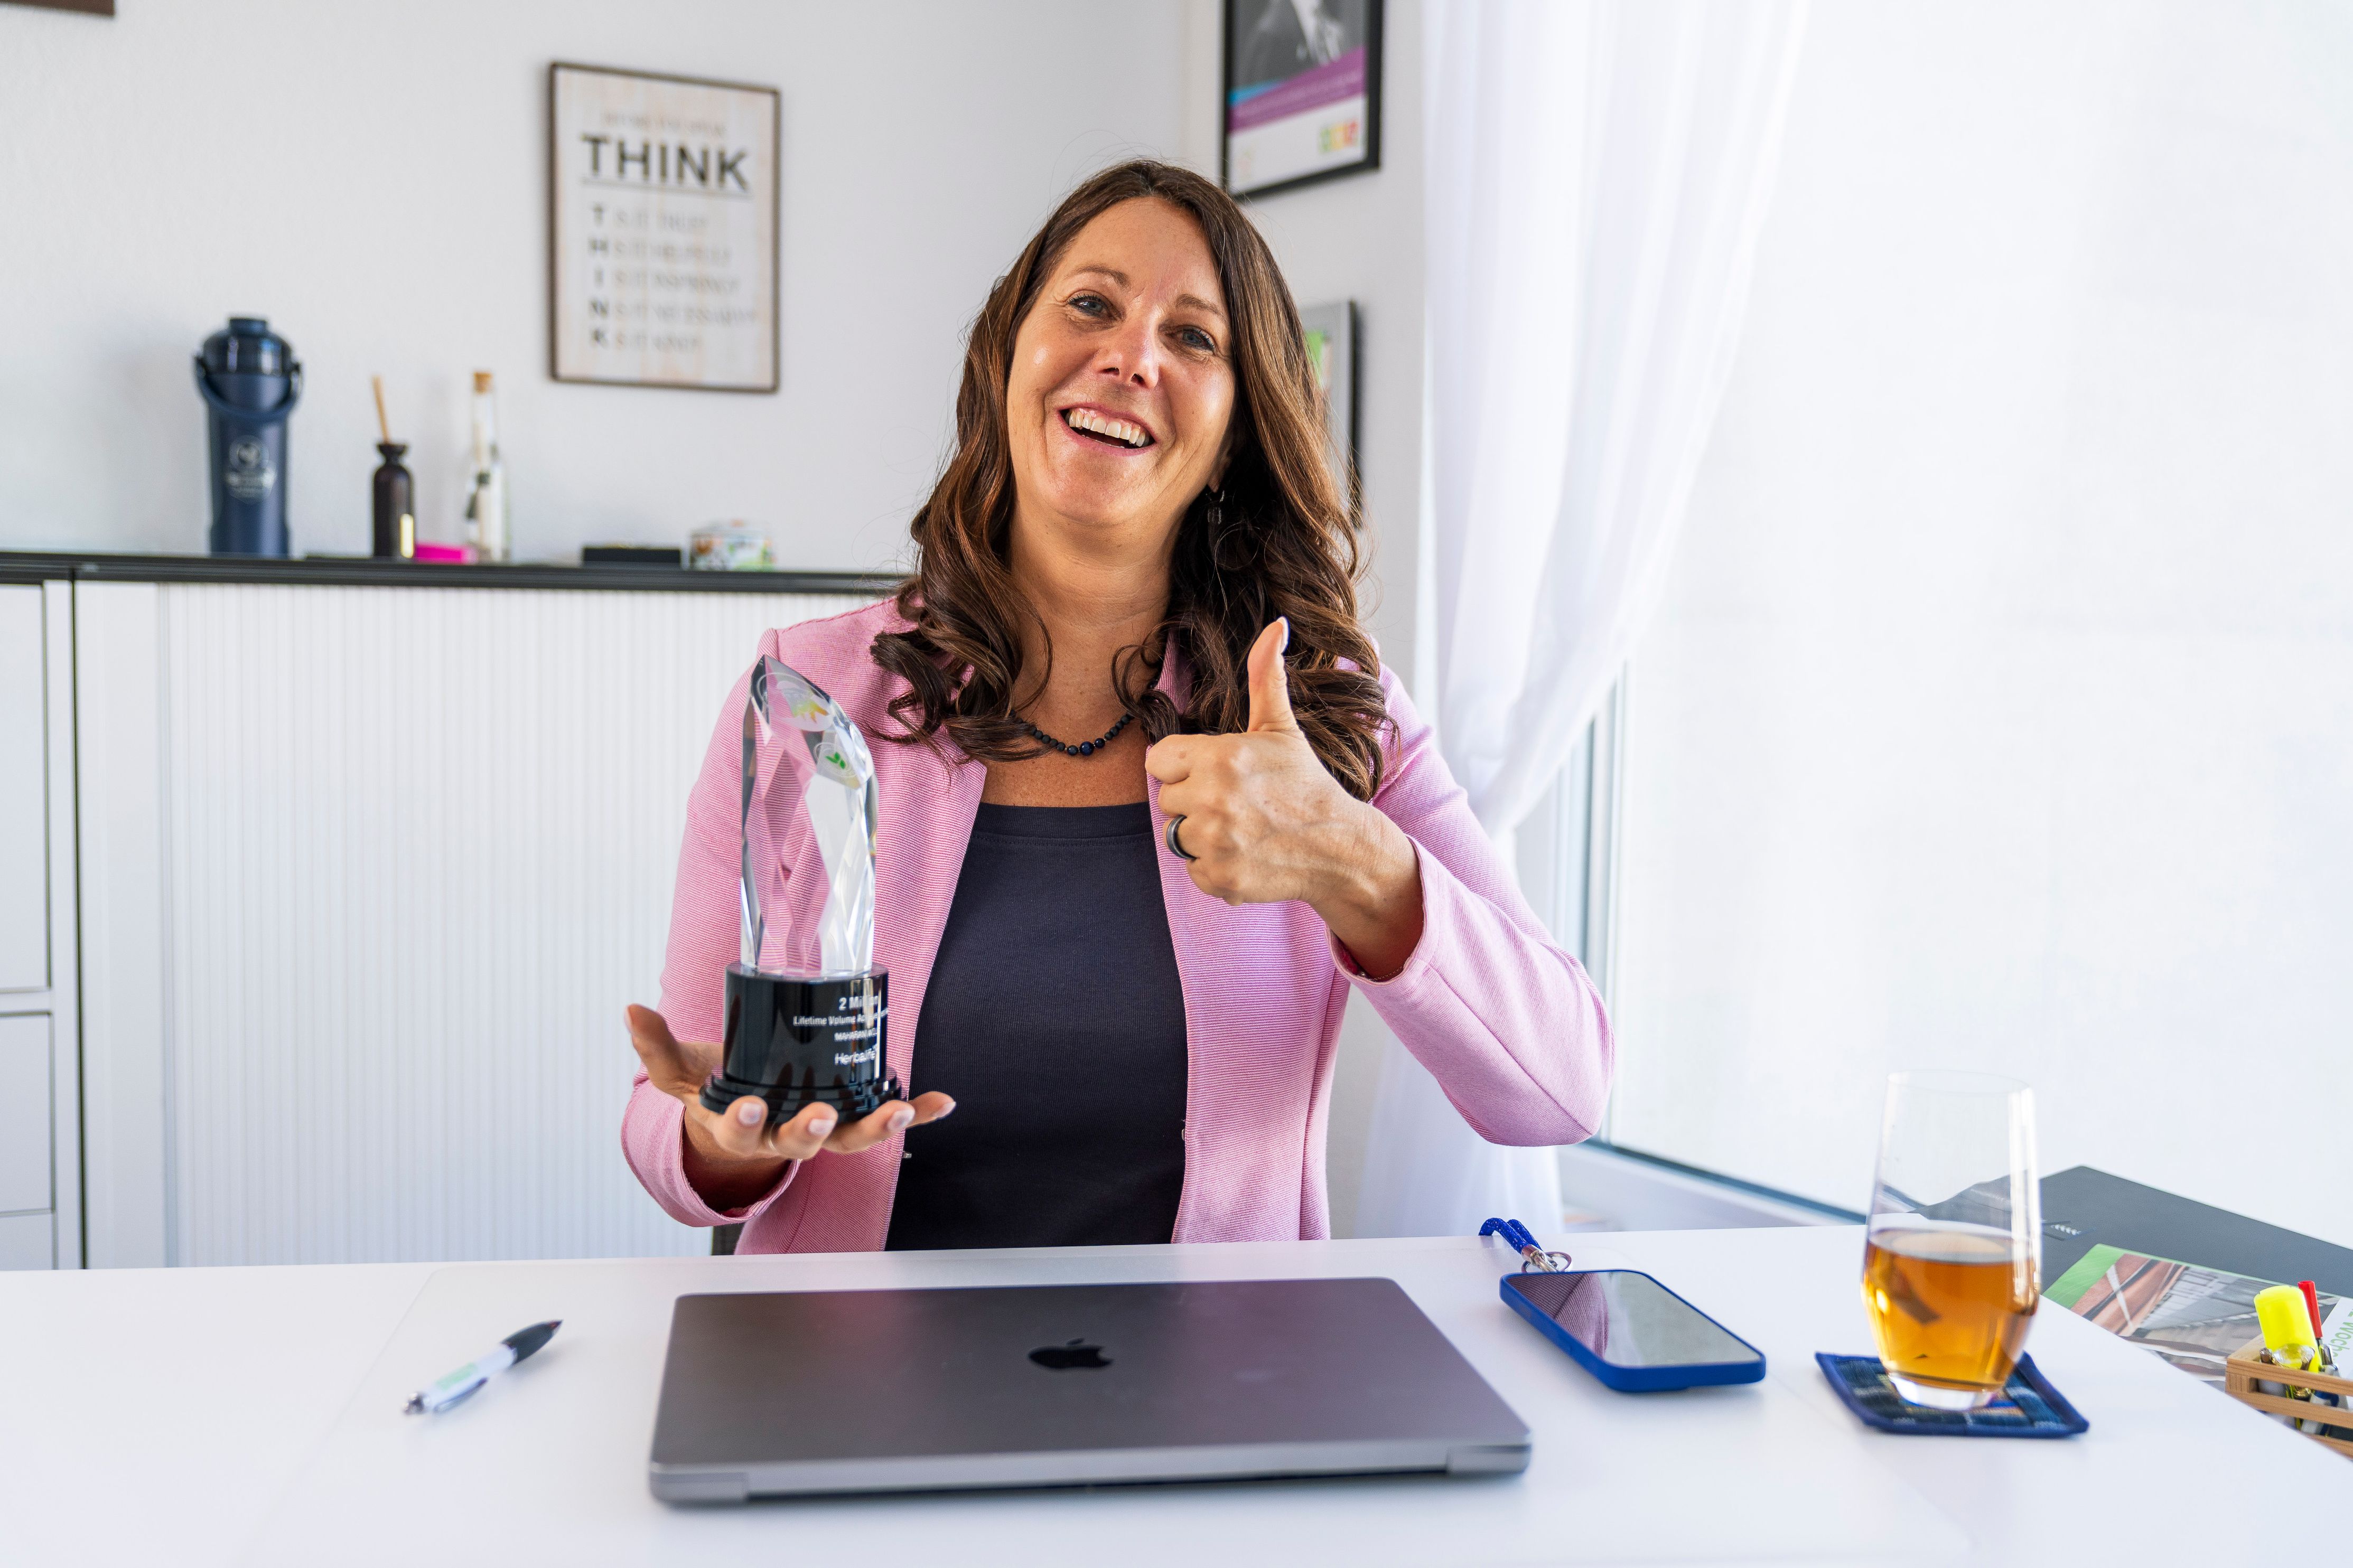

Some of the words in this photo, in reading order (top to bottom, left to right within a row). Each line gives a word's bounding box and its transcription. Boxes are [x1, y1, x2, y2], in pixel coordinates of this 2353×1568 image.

[580, 132, 749, 193] THINK
[838, 997, 847, 1011] 2
[793, 1016, 827, 1027] Lifetime
[828, 1015, 856, 1026] Volume
